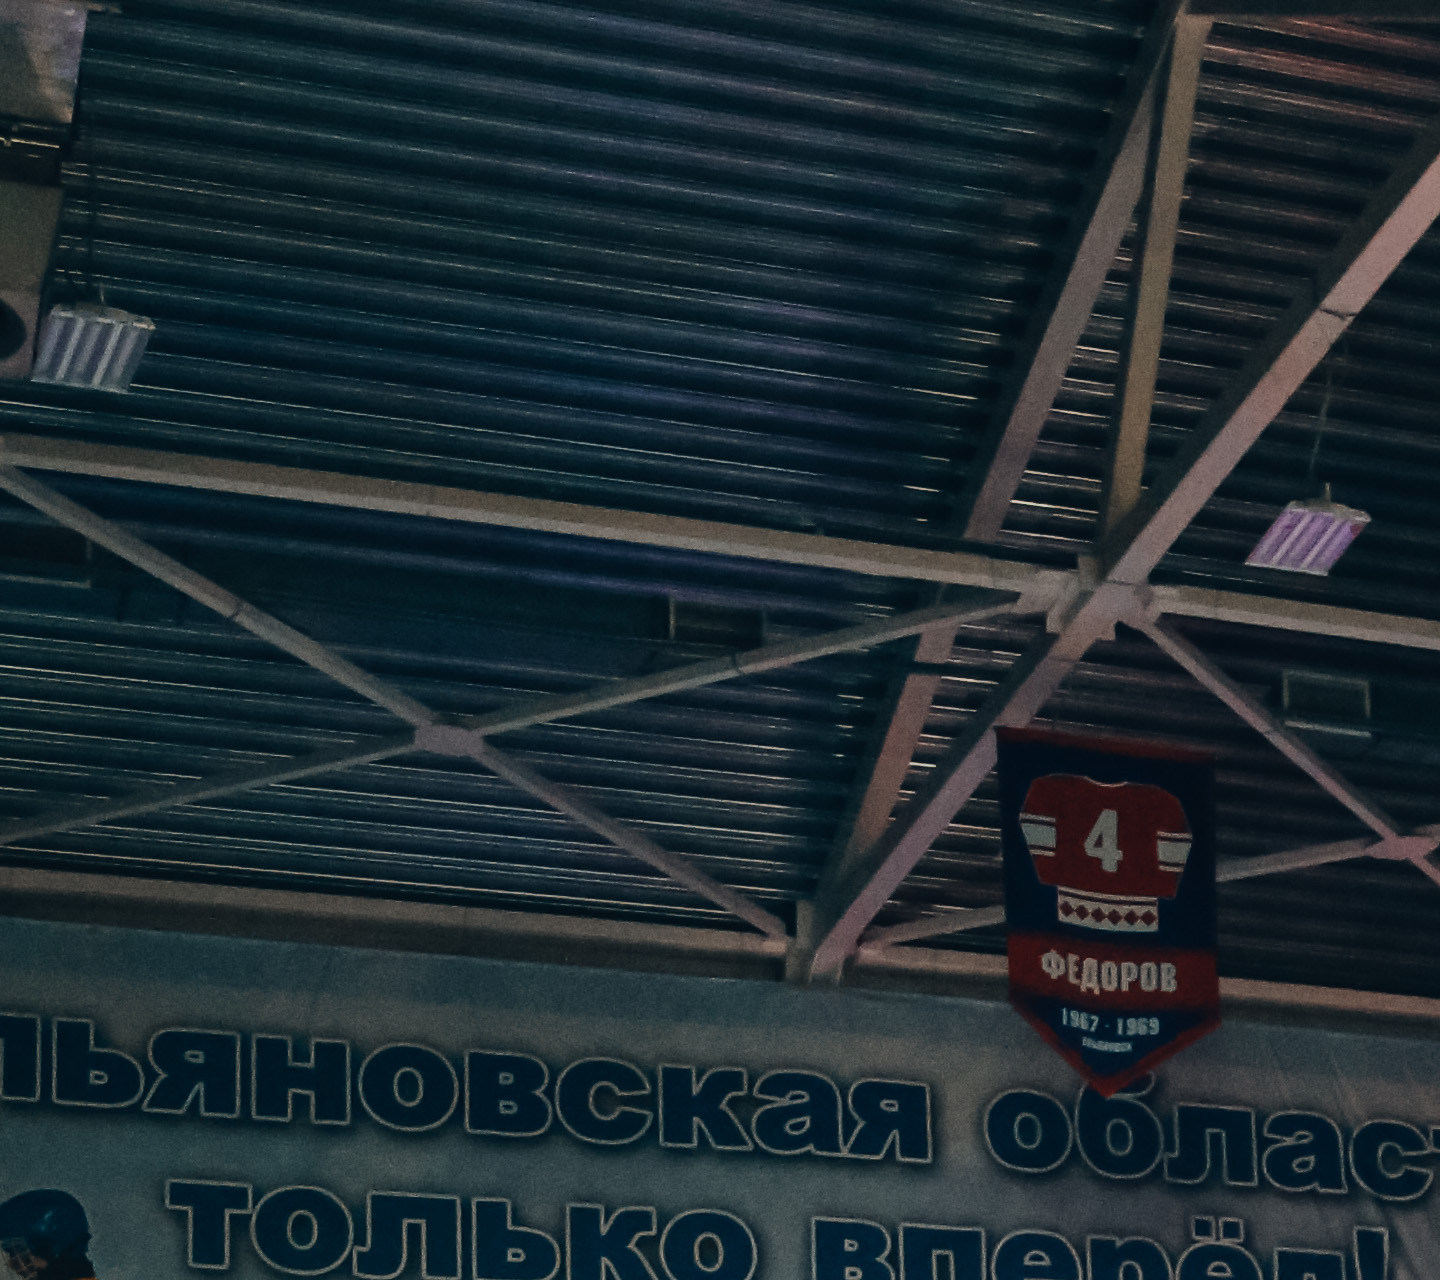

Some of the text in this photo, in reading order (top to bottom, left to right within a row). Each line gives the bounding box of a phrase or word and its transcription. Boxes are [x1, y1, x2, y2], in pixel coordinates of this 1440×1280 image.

[1083, 808, 1124, 873] 4
[1040, 948, 1178, 996] ФЕДОРОВ
[1061, 1007, 1100, 1033] 1967
[1116, 1016, 1160, 1037] 1969
